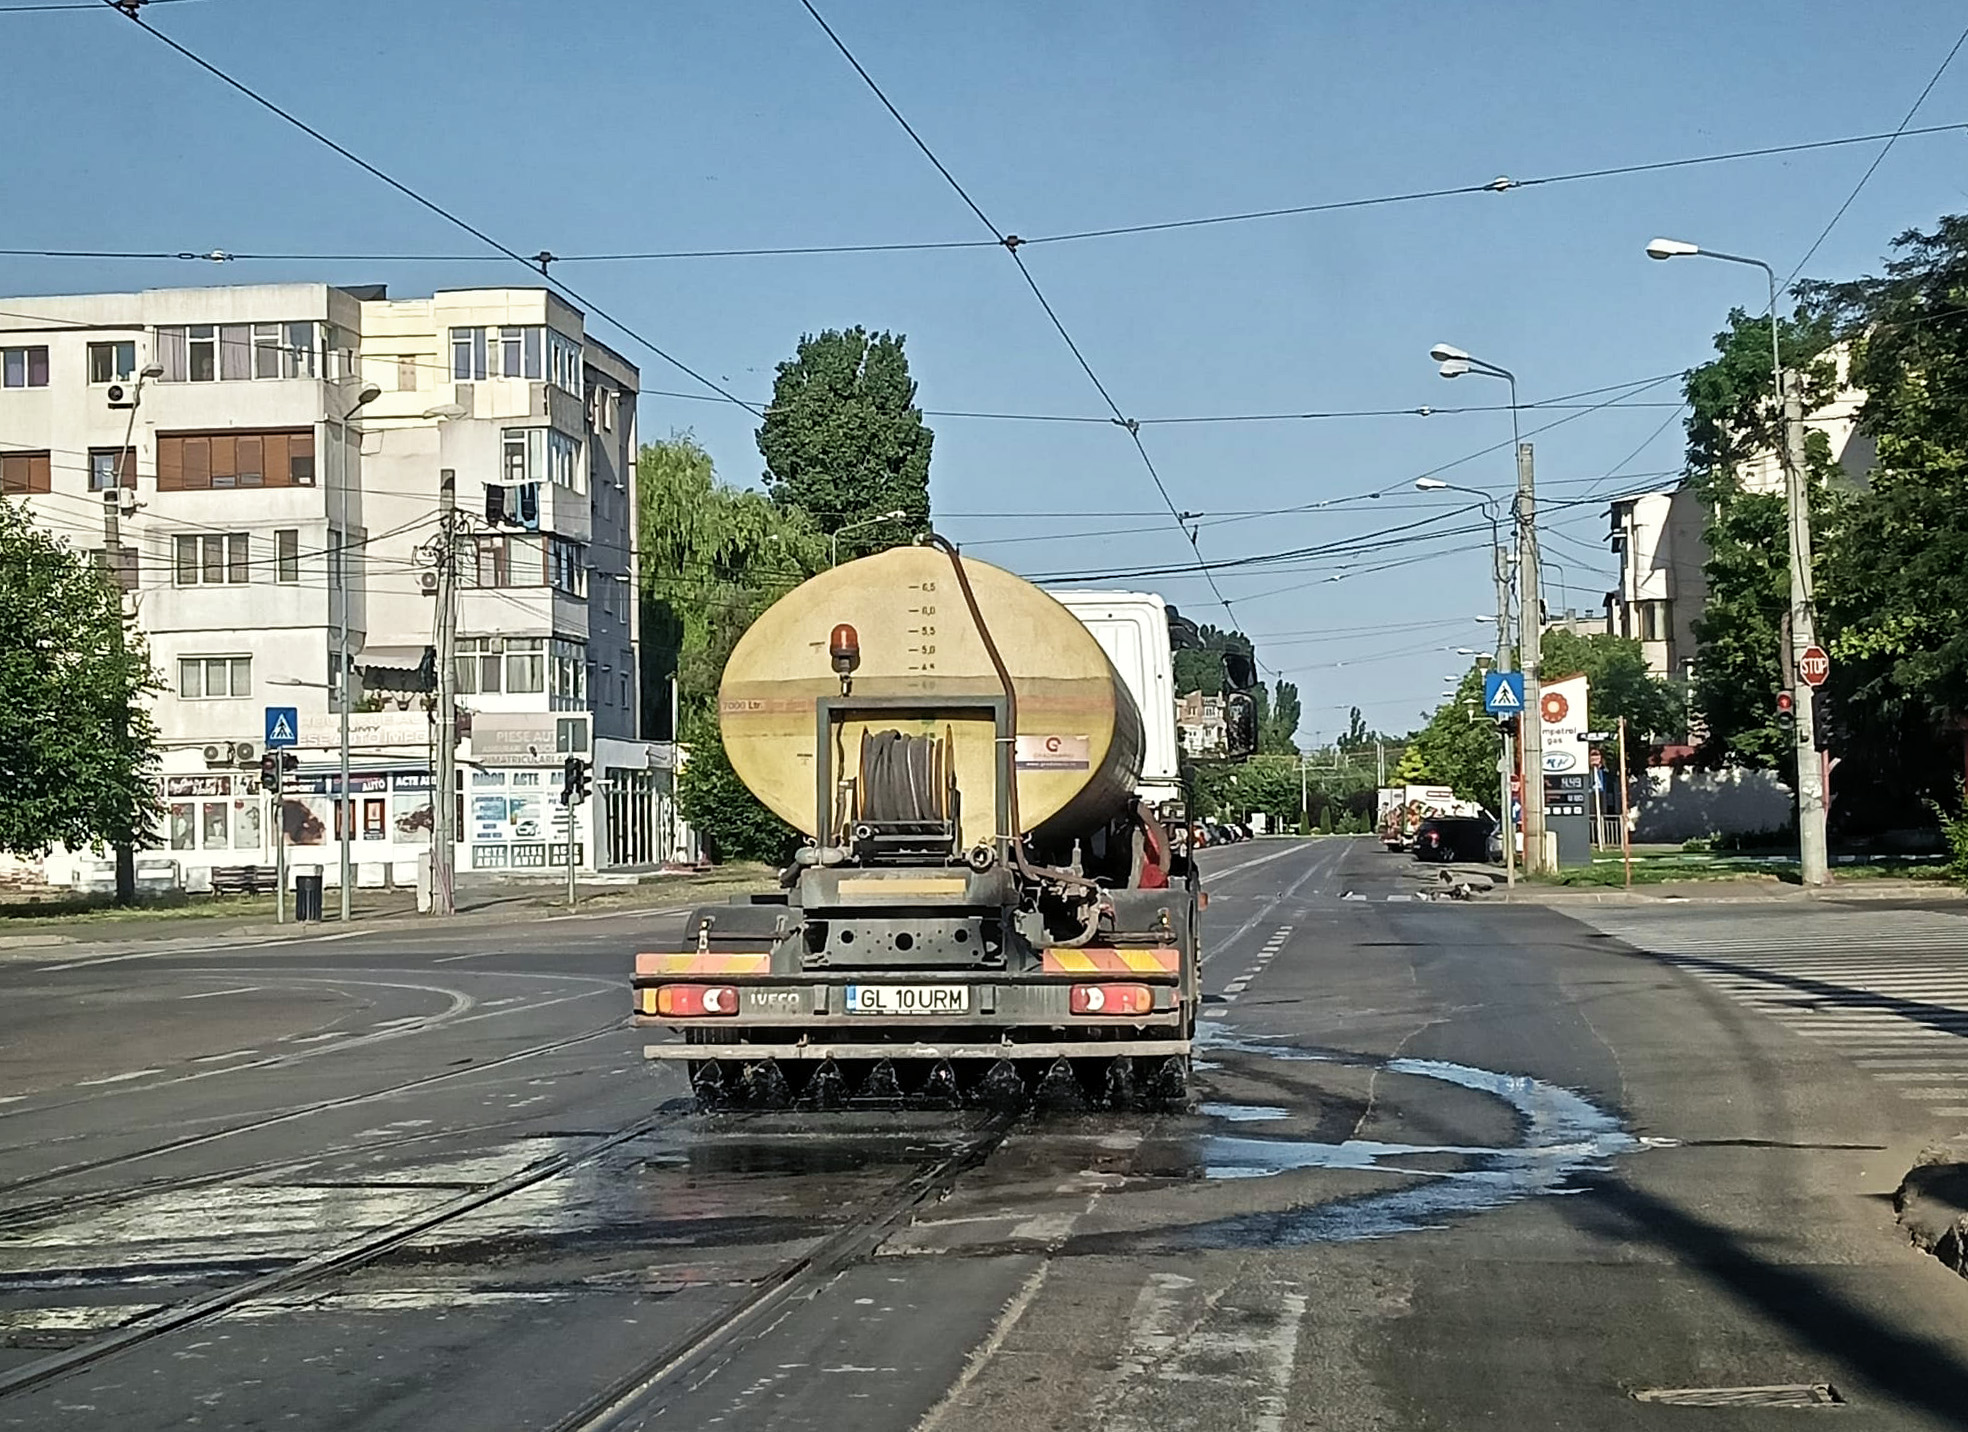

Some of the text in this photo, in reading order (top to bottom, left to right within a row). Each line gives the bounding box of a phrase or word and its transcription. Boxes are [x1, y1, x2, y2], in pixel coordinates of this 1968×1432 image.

[1801, 658, 1827, 674] STOP
[723, 701, 746, 710] 7000
[496, 731, 532, 742] PIESE
[1547, 738, 1562, 746] gas
[513, 772, 539, 785] ACTE
[362, 780, 386, 791] AUTO
[476, 847, 505, 857] ACTE
[513, 847, 543, 856] PIESE
[475, 856, 506, 867] AUTO
[514, 855, 543, 866] AUTO
[750, 993, 800, 1005] IVECO
[861, 989, 962, 1008] GL 10 URM
